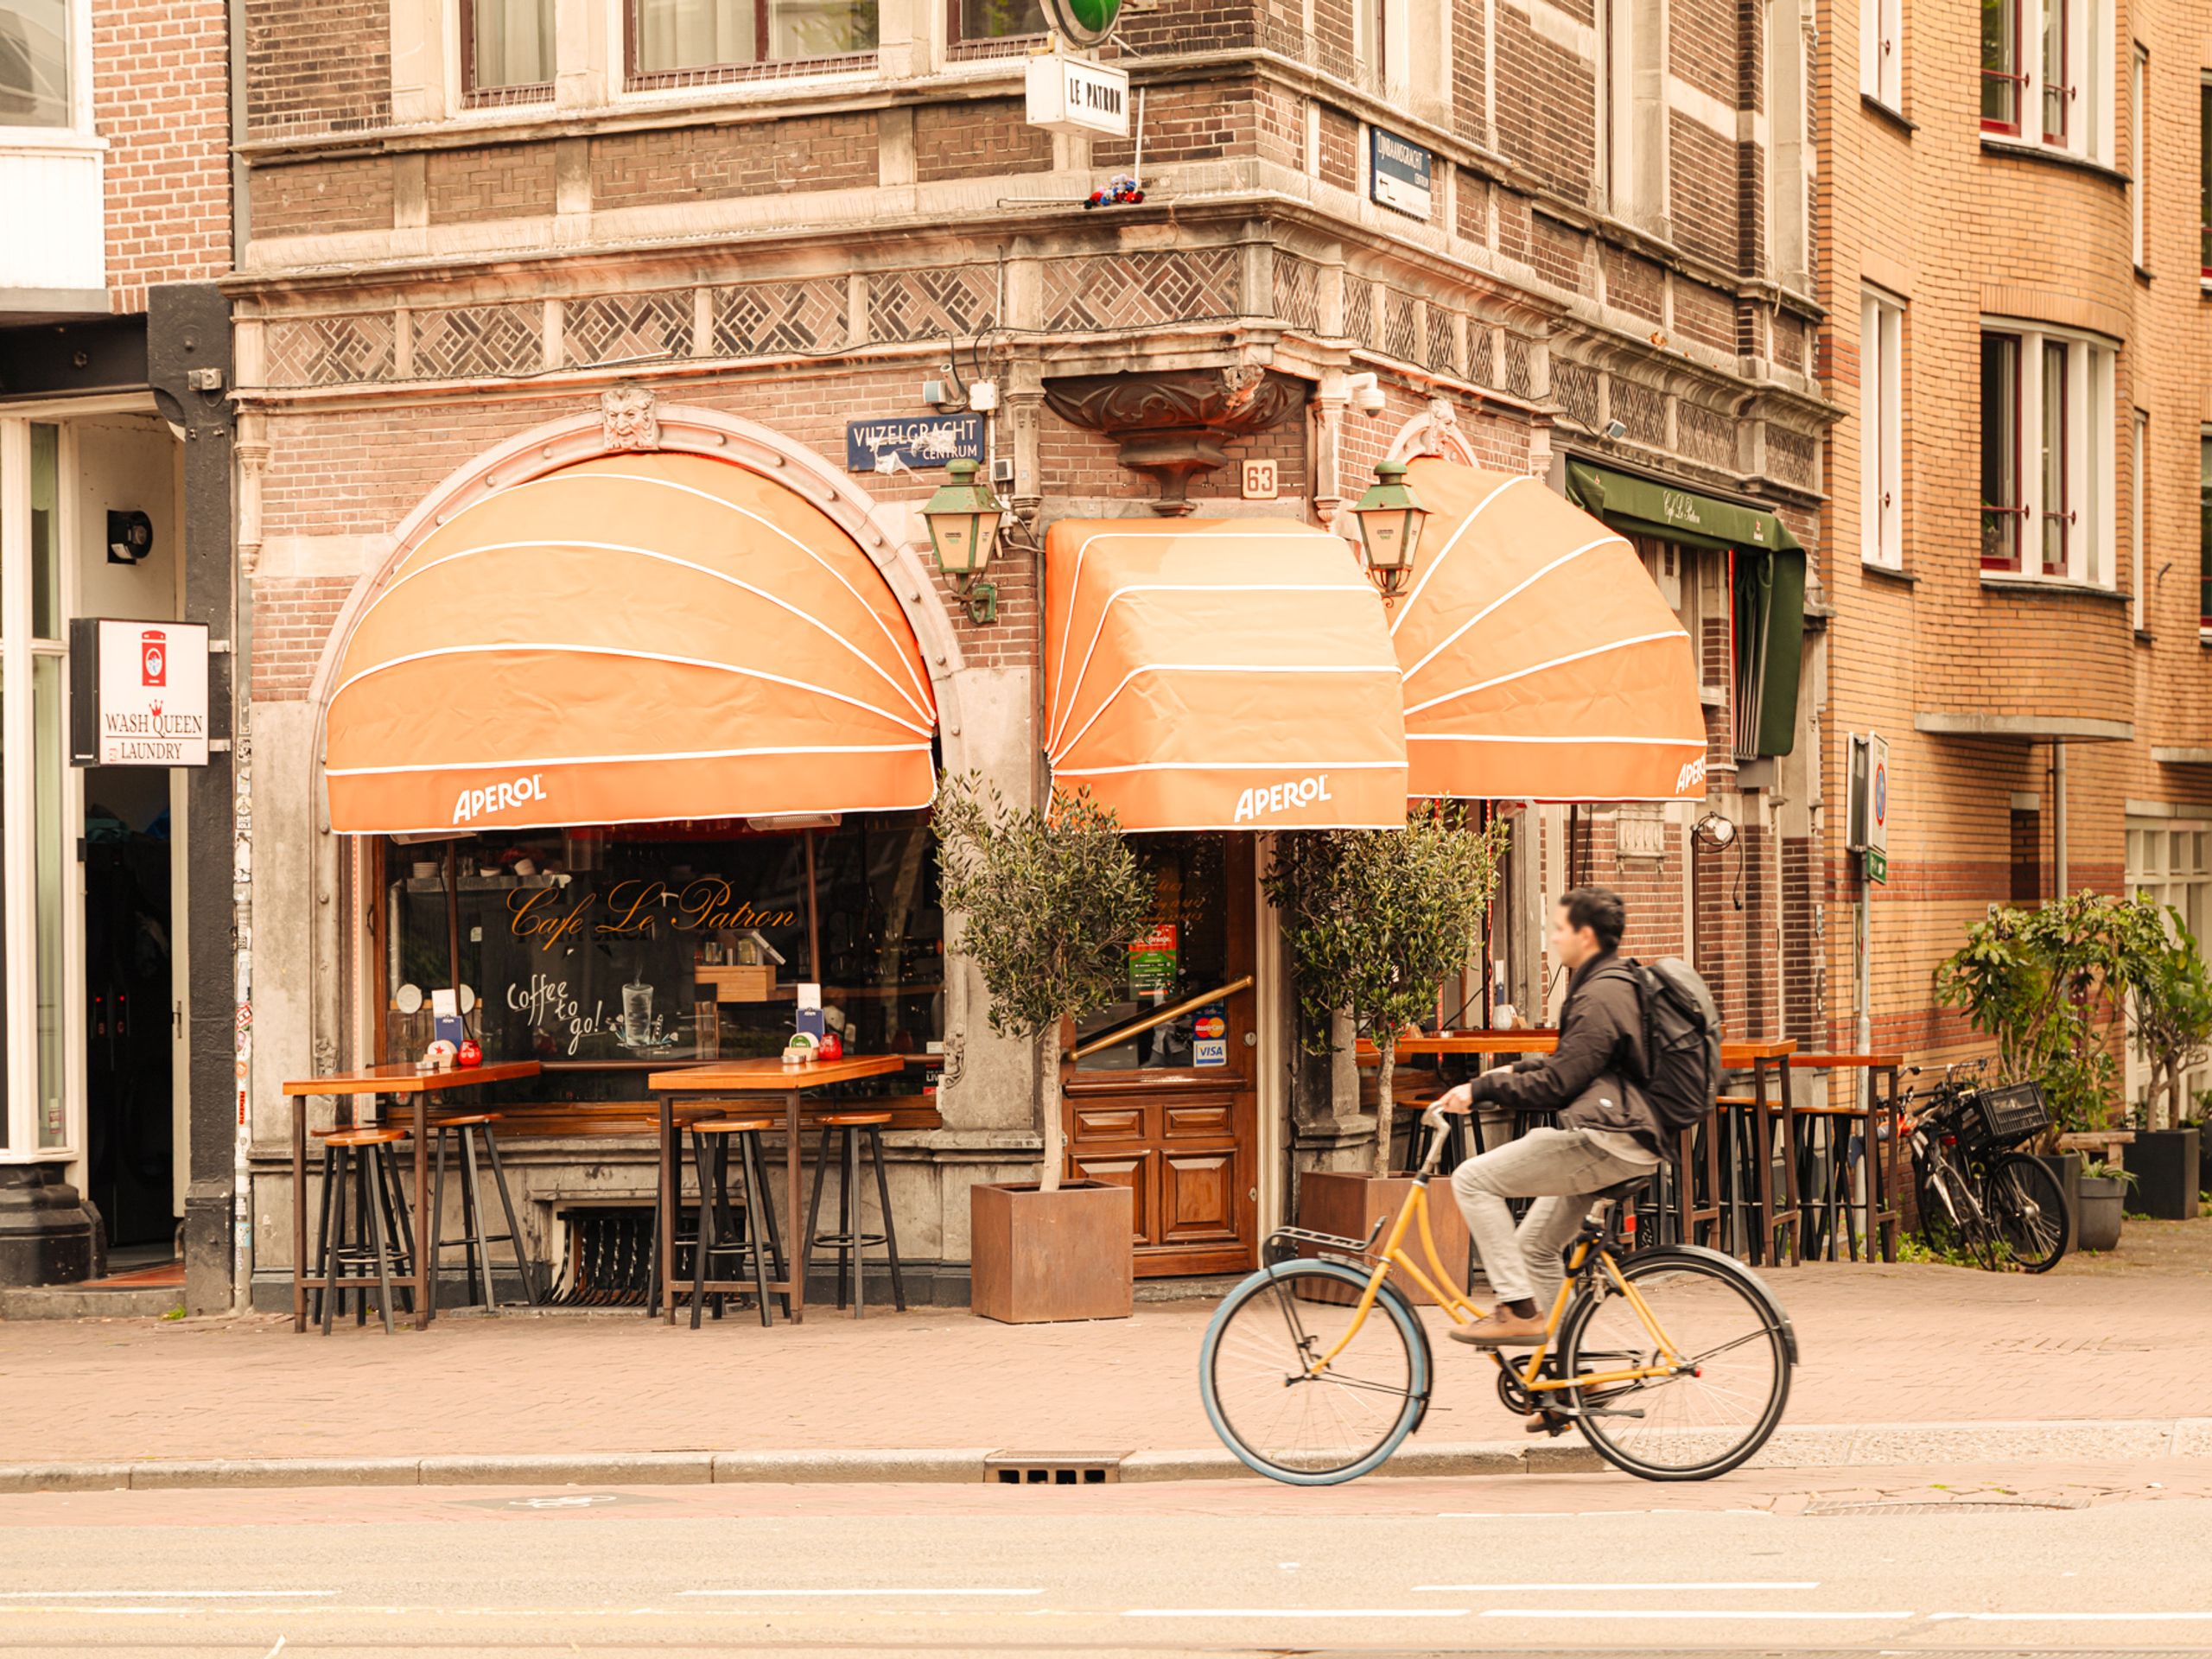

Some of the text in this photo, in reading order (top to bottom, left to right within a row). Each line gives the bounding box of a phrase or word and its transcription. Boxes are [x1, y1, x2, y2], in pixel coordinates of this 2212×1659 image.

[1070, 77, 1121, 115] LE PATRON
[1247, 467, 1273, 492] 63
[105, 714, 202, 739] WASH QUEEN
[121, 742, 182, 760] LAUNDRY
[453, 773, 547, 825] APEROL
[1234, 774, 1332, 823] APEROL
[595, 880, 666, 933] Le
[671, 877, 798, 931] Patron
[507, 974, 569, 1027] Coffee
[554, 999, 578, 1020] to
[568, 1000, 603, 1056] go!
[1199, 1046, 1223, 1057] VISA
